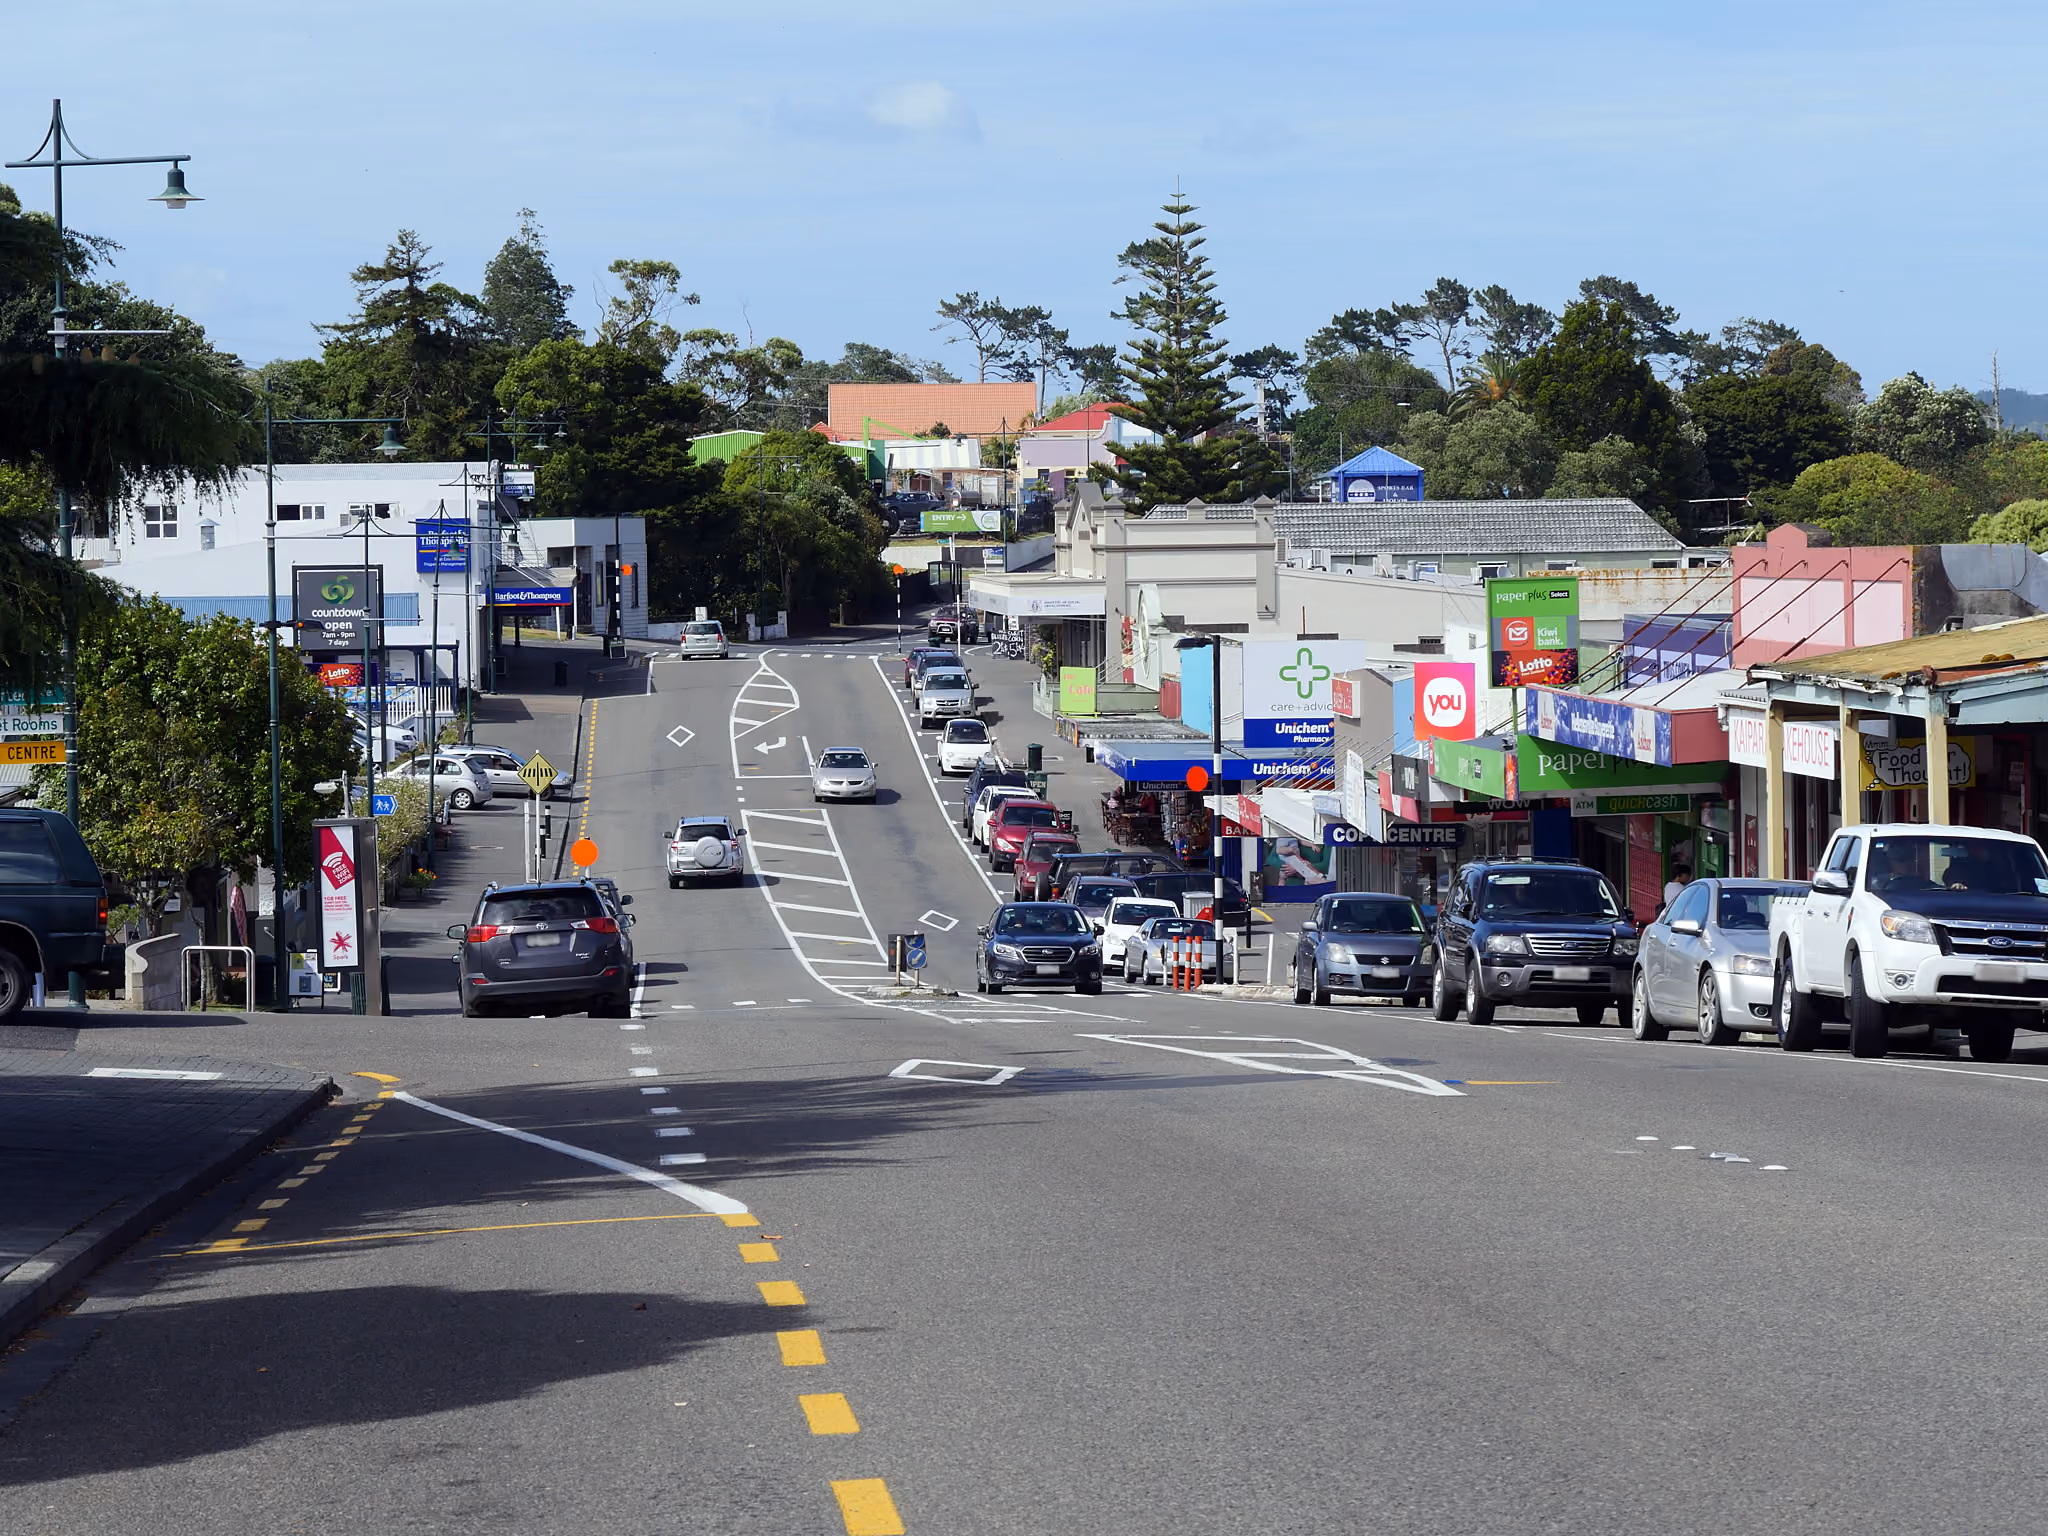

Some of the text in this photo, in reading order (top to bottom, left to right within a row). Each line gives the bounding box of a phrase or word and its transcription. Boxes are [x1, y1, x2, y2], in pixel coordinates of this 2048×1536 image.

[1550, 590, 1568, 598] Select
[312, 607, 365, 617] countdown
[325, 621, 353, 631] open
[1537, 628, 1557, 637] Kiwi
[340, 631, 356, 639] 9pm
[1519, 658, 1553, 672] Lotto
[328, 667, 350, 677] Lotto
[1428, 694, 1462, 716] you
[12, 718, 58, 731] Rooms
[1275, 721, 1330, 734] Unichem
[1293, 735, 1330, 743] Pharmacy
[1734, 719, 1767, 756] KAIPAR
[7, 745, 57, 760] CENTRE
[1878, 750, 1921, 769] Food
[1253, 762, 1312, 775] Unichem
[1887, 762, 1967, 782] Thout!
[1142, 781, 1179, 789] Unichem
[1576, 800, 1594, 810] ATM
[1332, 827, 1457, 842] COP CENTRE
